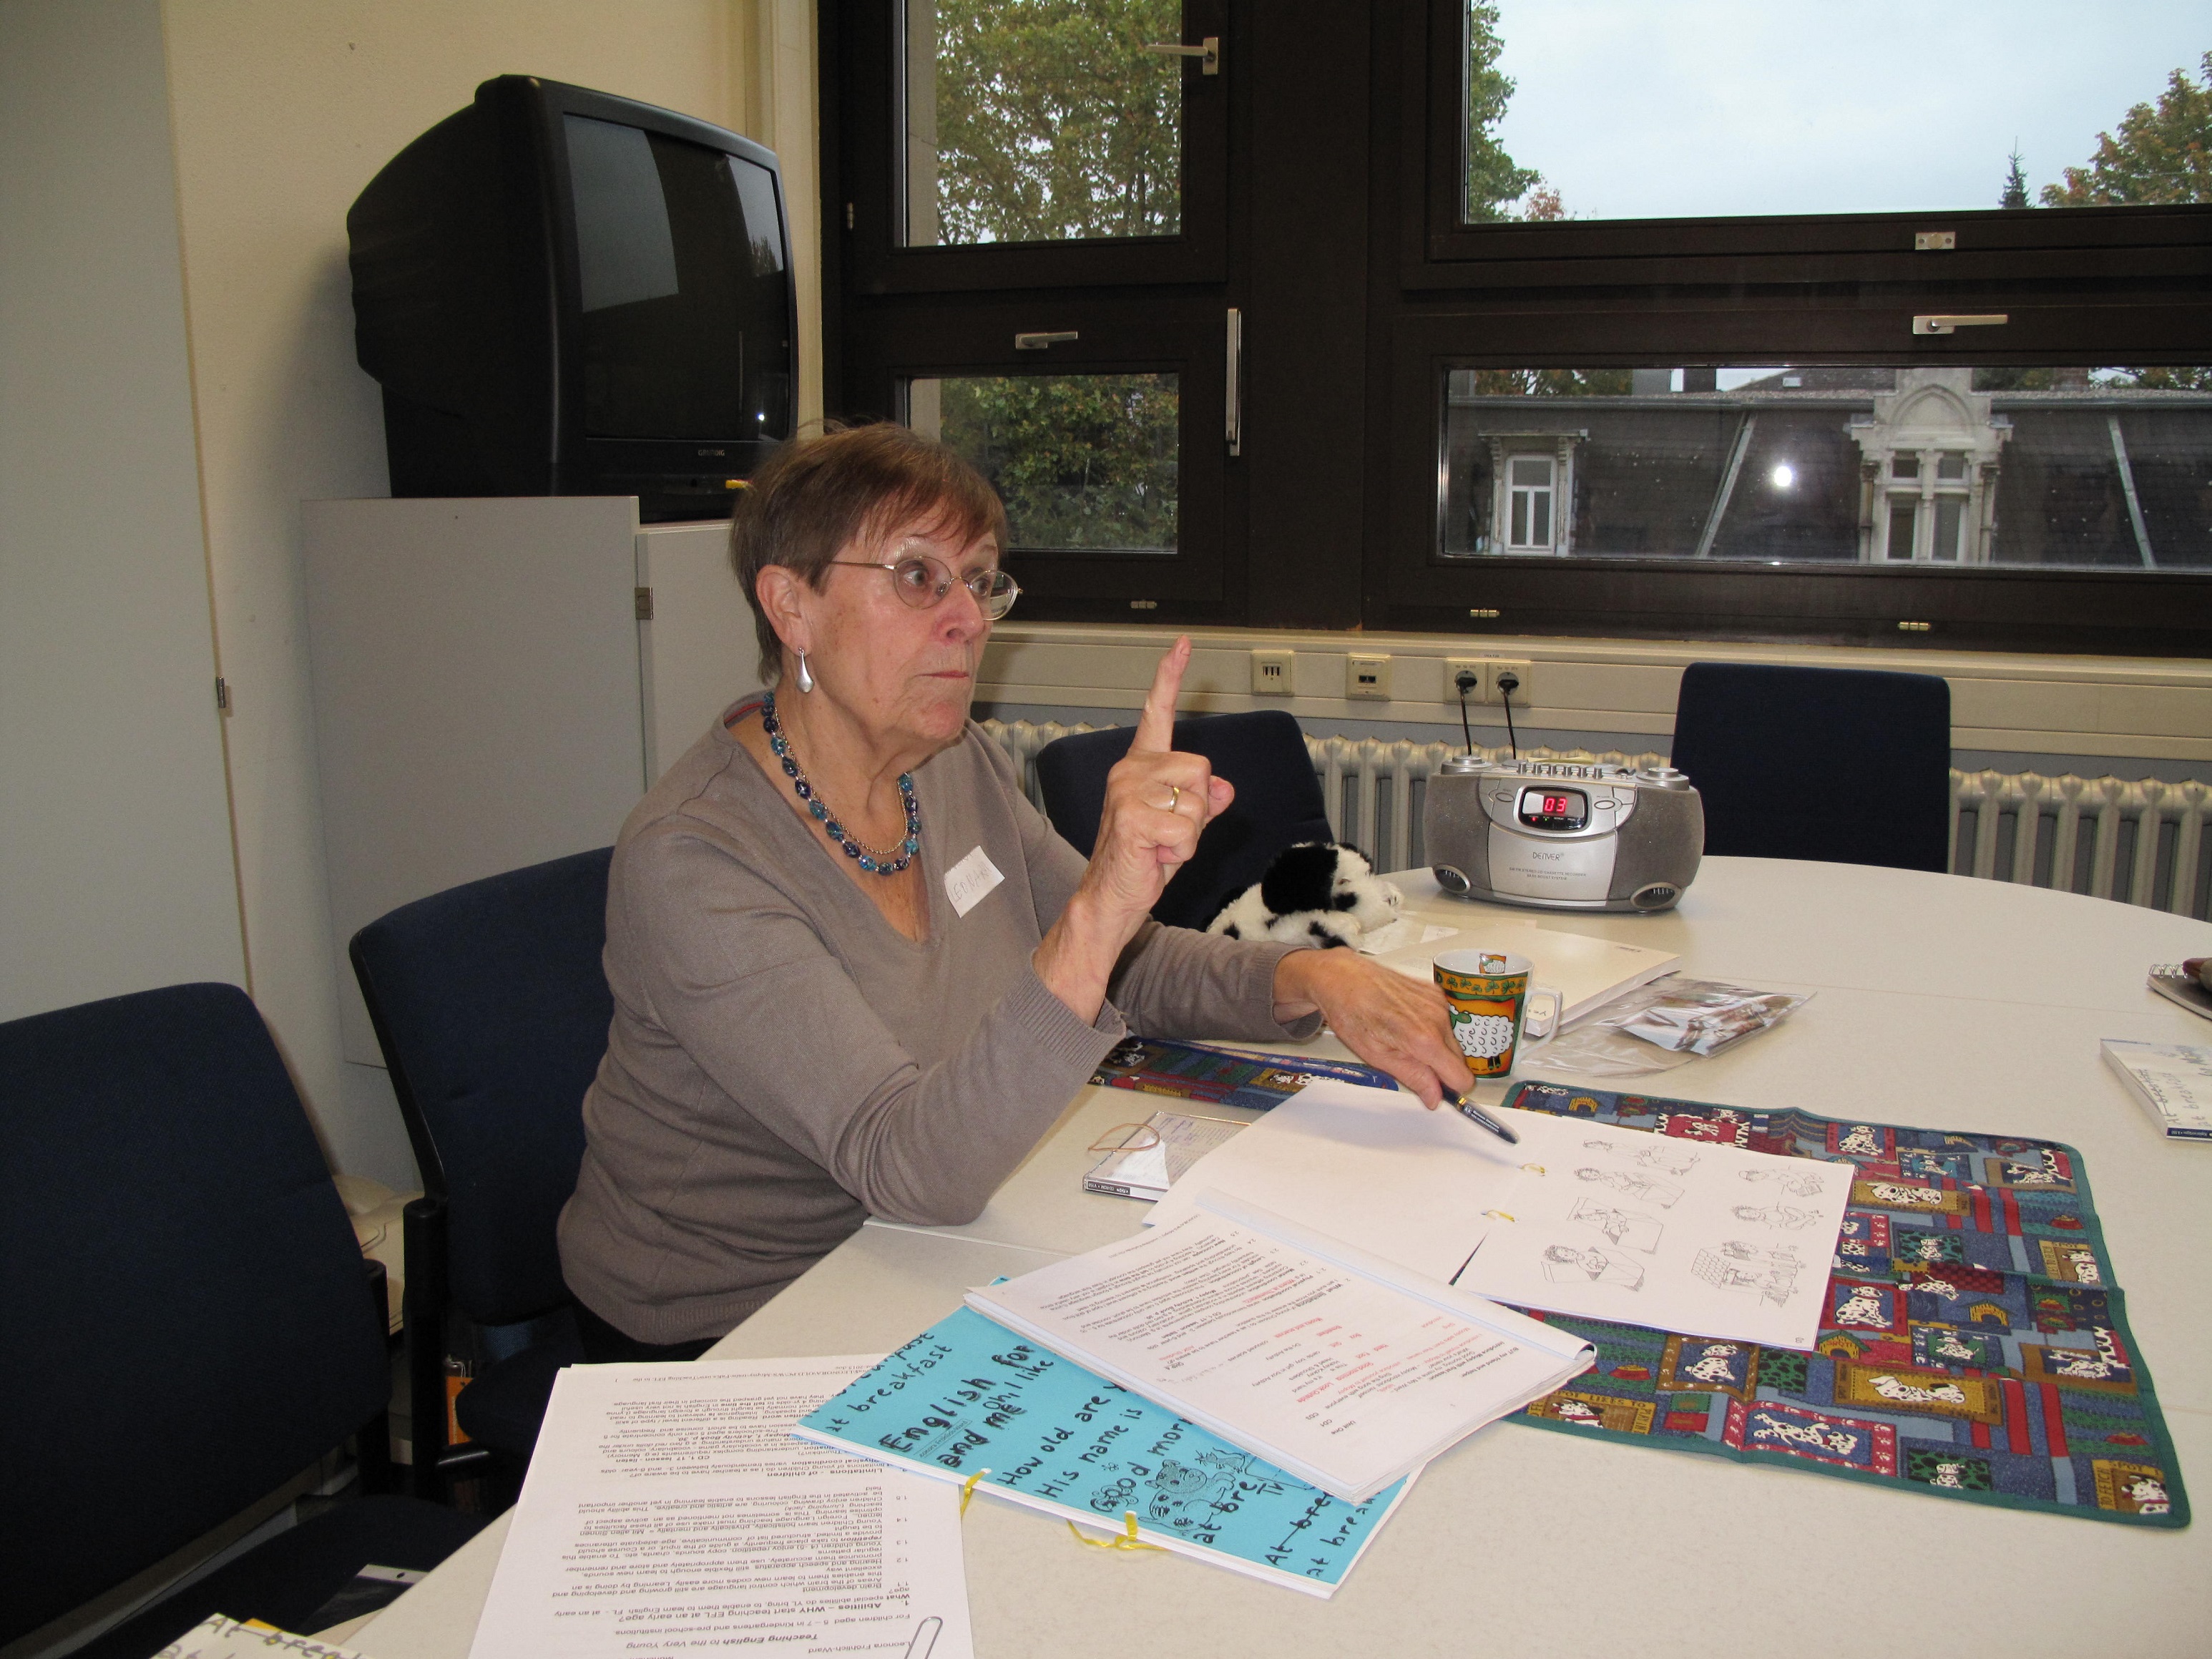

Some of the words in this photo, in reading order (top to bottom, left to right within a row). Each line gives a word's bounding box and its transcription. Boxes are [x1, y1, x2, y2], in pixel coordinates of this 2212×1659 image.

[1532, 851, 1560, 861] DENVER
[879, 1376, 997, 1453] English
[992, 1345, 1036, 1368] for
[1345, 1419, 1356, 1428] Unit
[1331, 1426, 1345, 1436] One
[997, 1457, 1043, 1485] How
[1041, 1426, 1075, 1452] old
[1075, 1396, 1111, 1422] are
[936, 1429, 991, 1468] and
[1034, 1470, 1079, 1497] His
[1078, 1424, 1129, 1463] name
[1120, 1408, 1142, 1419] is
[708, 1583, 746, 1592] language
[803, 1584, 856, 1593] development
[572, 1589, 617, 1597] developing
[854, 1594, 884, 1603] special
[628, 1606, 660, 1615] English
[838, 1602, 881, 1611] Abilities
[728, 1607, 770, 1618] teaching
[619, 1615, 645, 1623] age?
[647, 1613, 672, 1622] early
[665, 1625, 710, 1634] pre-school
[733, 1620, 793, 1630] Kindergartens
[723, 1635, 765, 1645] English
[769, 1633, 818, 1643] Teaching
[626, 1641, 659, 1650] Young
[663, 1640, 686, 1648] Very
[808, 1644, 871, 1654] Fröhlich-Ward
